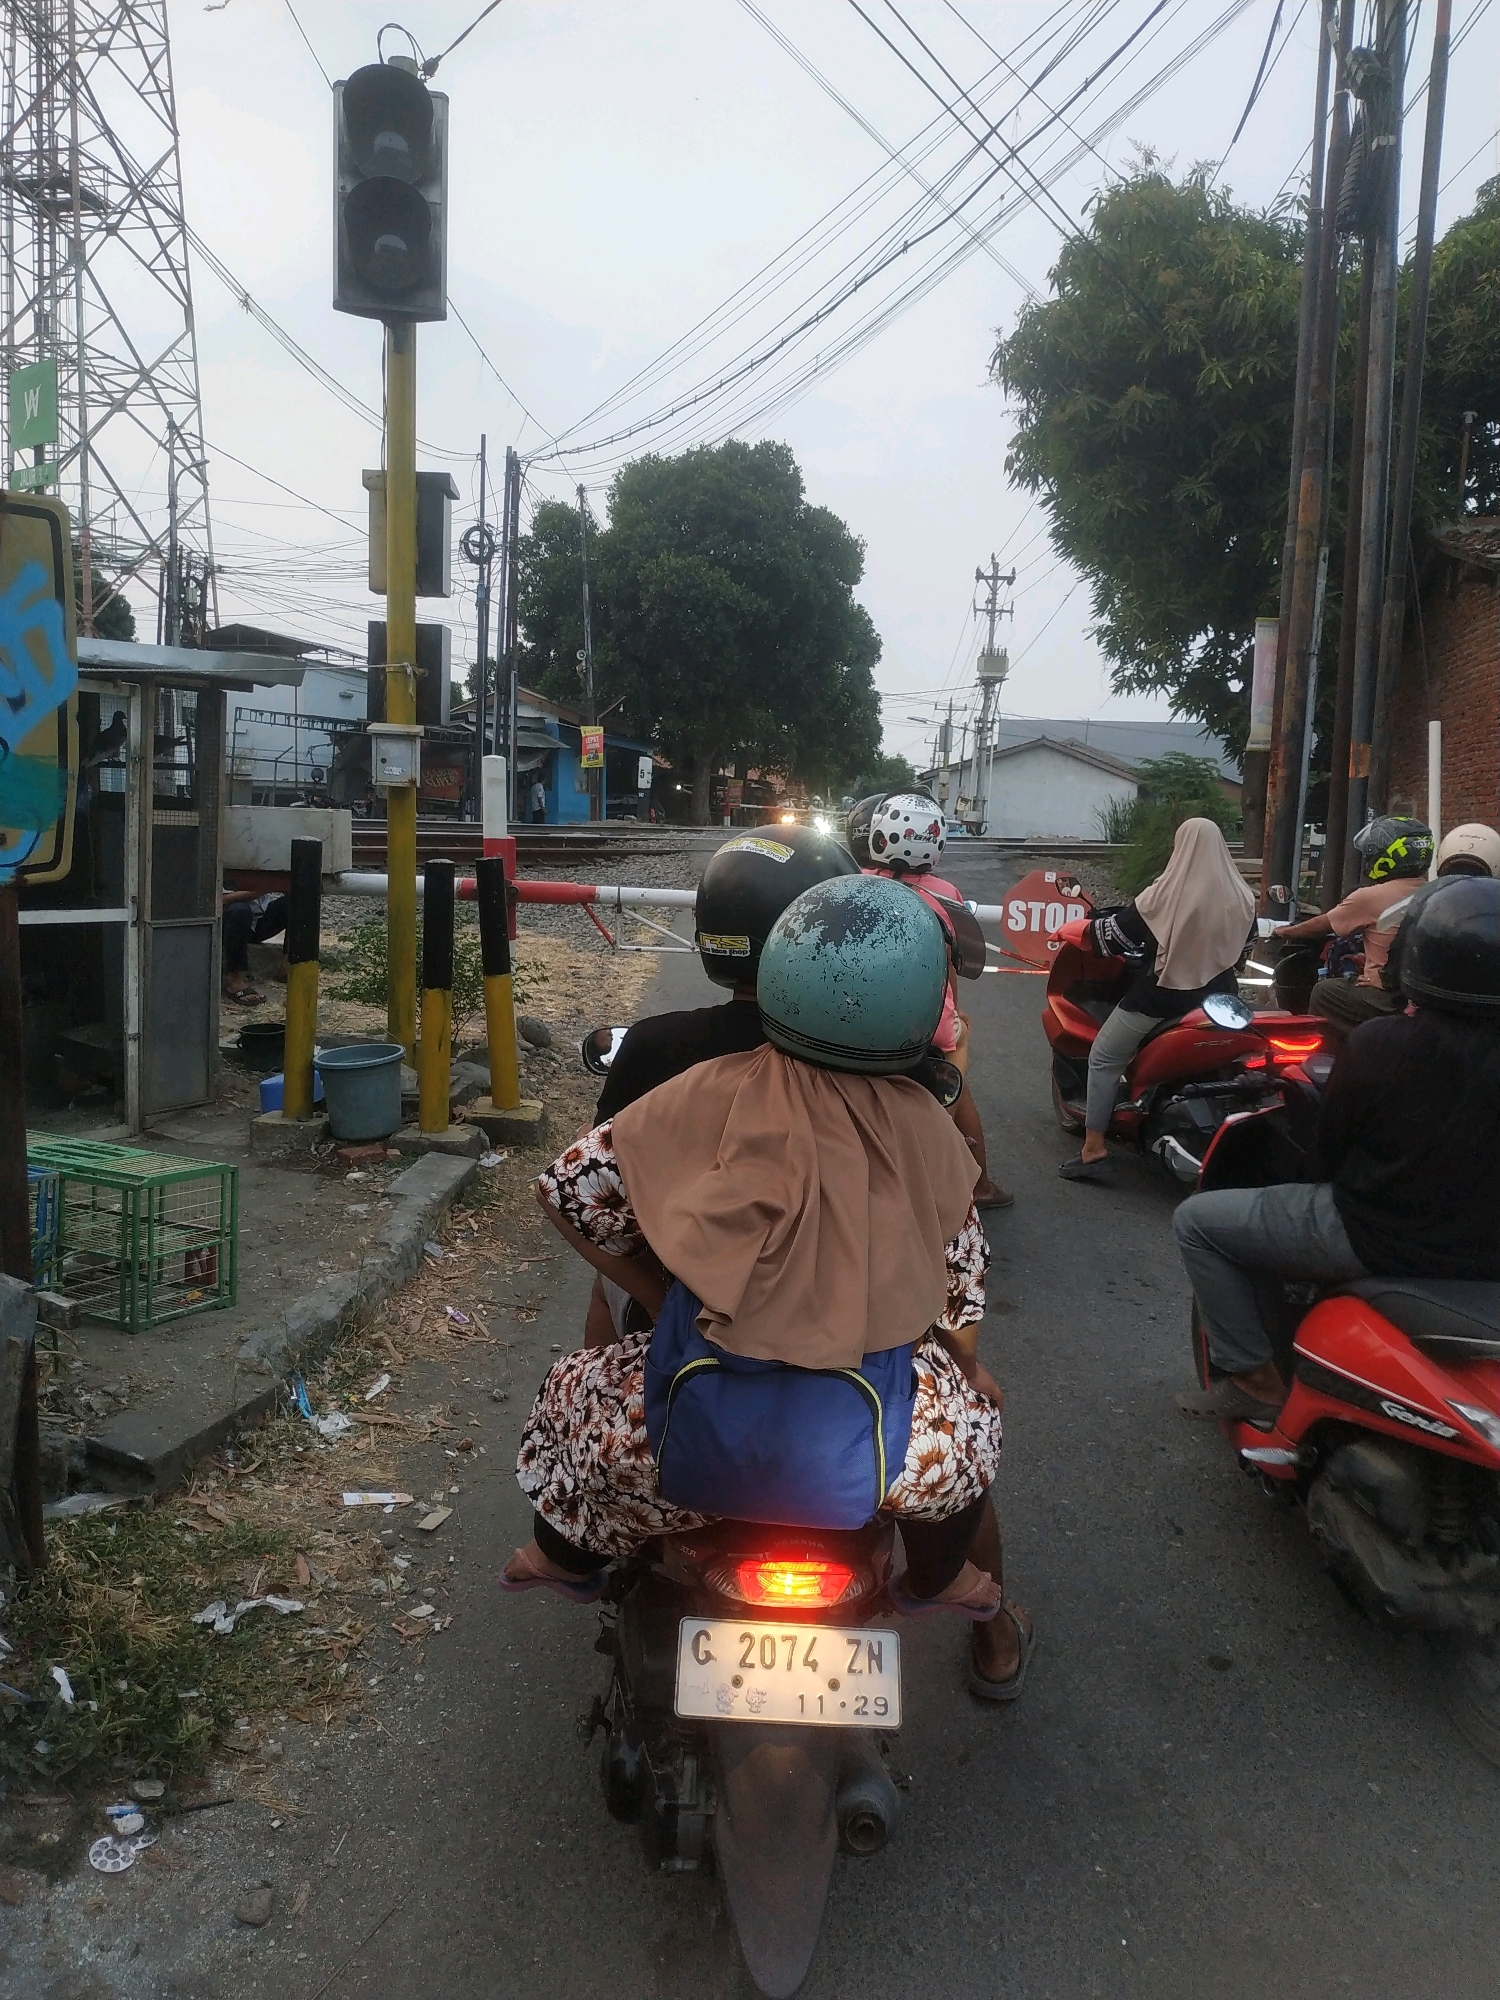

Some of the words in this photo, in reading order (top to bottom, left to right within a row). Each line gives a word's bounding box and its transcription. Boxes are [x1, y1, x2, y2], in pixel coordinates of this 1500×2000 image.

[640, 769, 645, 779] 5
[425, 775, 457, 788] SUPER
[1007, 900, 1085, 934] STOP
[773, 1539, 825, 1549] YAMAHA
[692, 1630, 717, 1666] G
[739, 1632, 819, 1672] 2074
[846, 1638, 883, 1675] ZN
